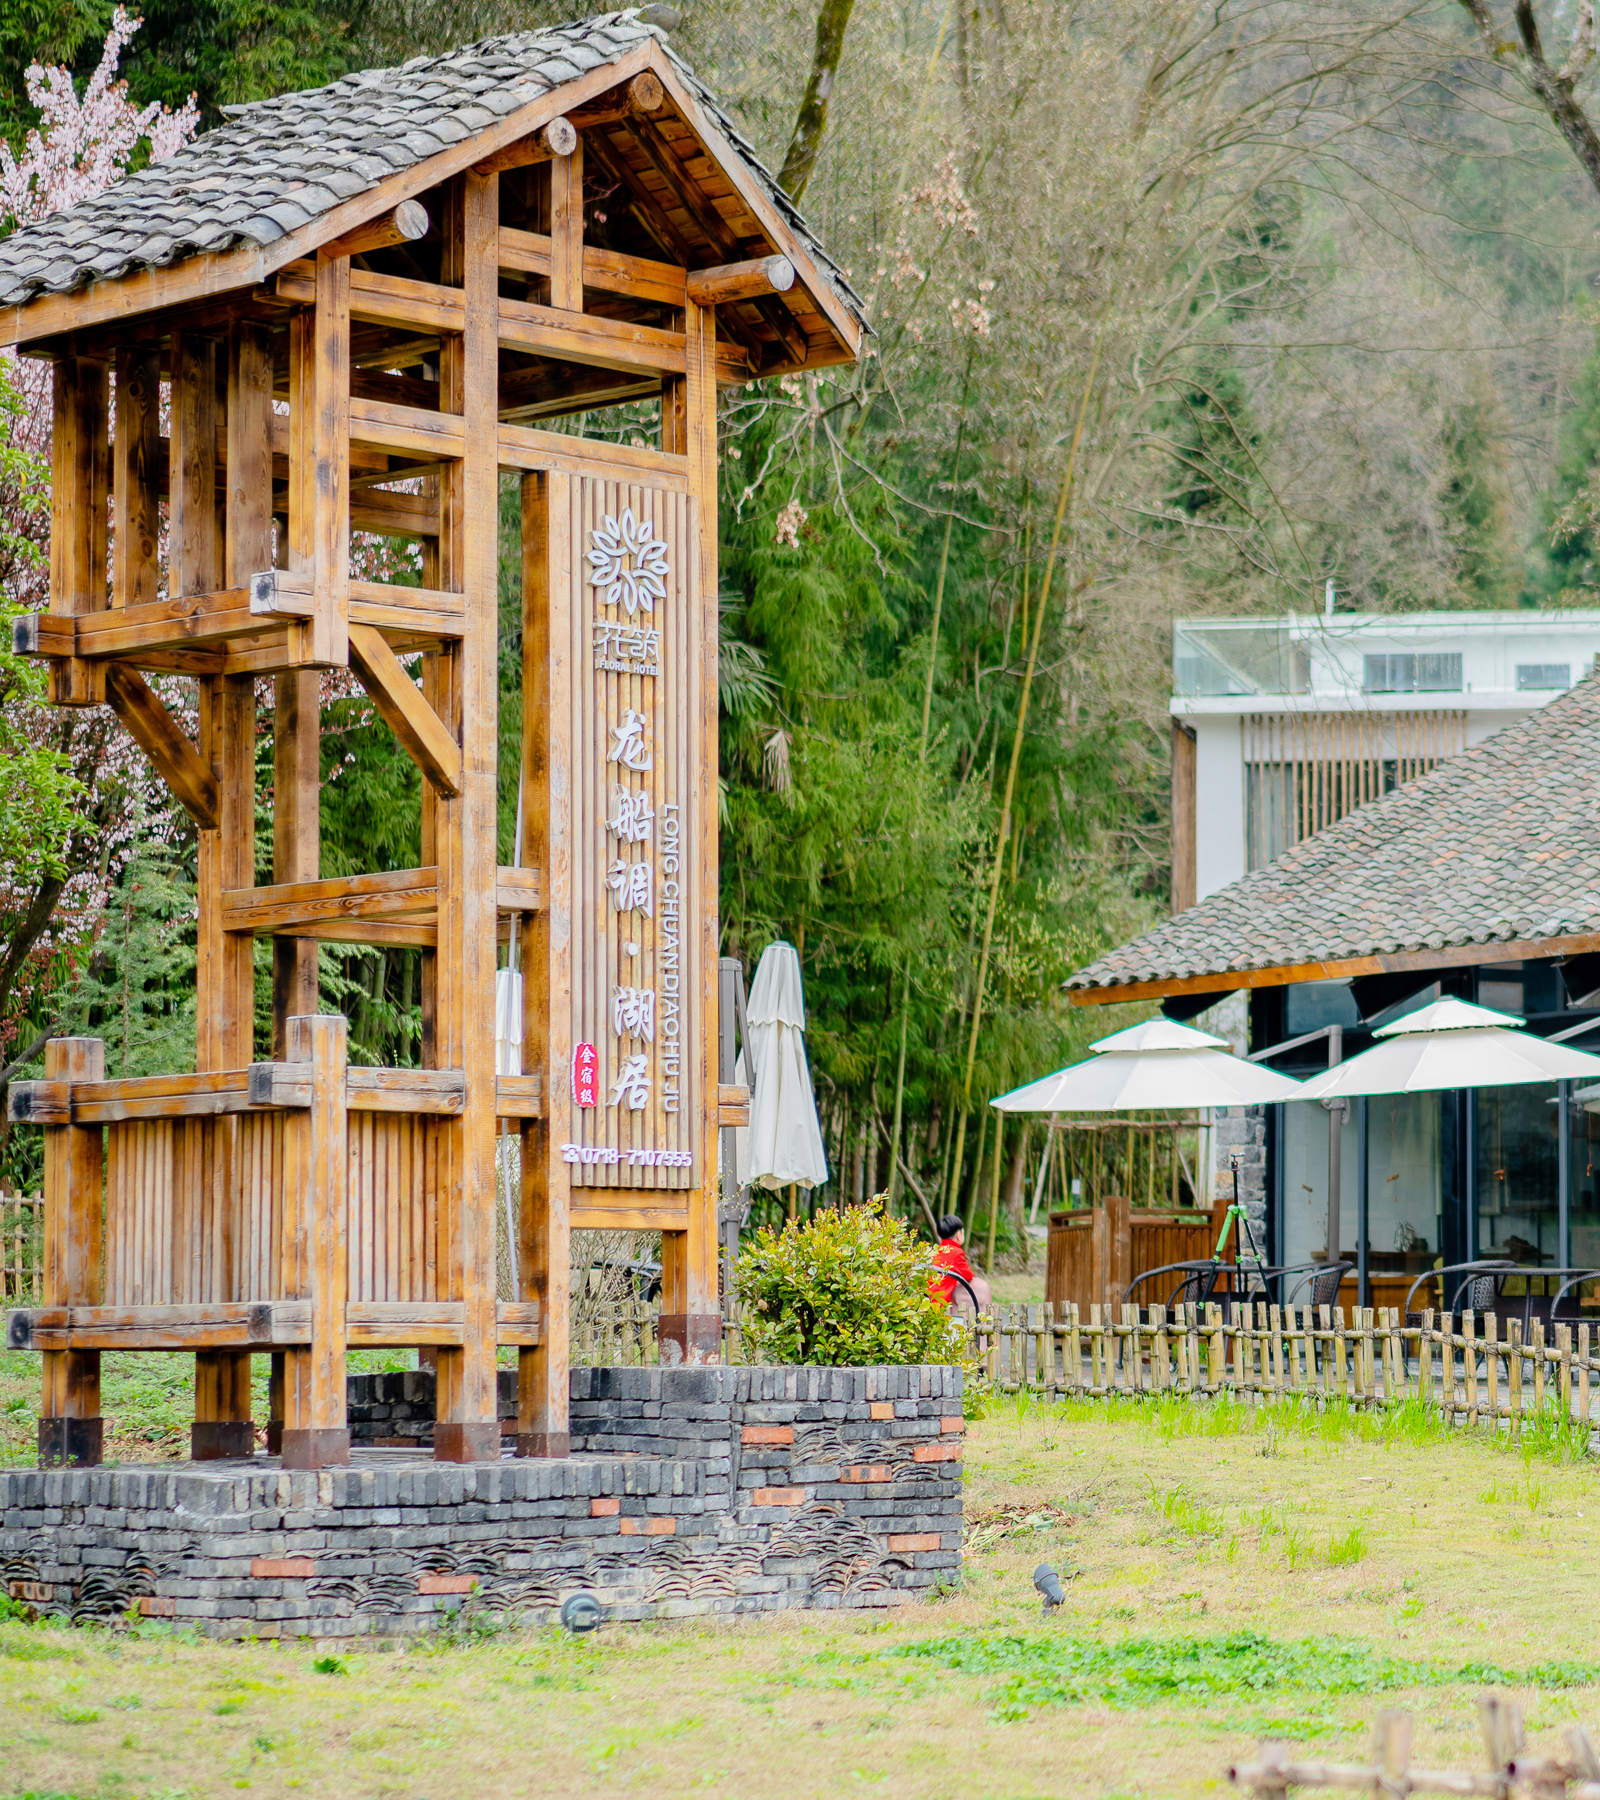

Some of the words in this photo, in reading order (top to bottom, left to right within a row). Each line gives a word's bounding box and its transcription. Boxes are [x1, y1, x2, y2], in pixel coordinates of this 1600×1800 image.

[596, 620, 661, 662] 花筑
[598, 659, 631, 673] FLORAL
[633, 663, 660, 676] HOTEL
[662, 803, 679, 875] LONG
[662, 880, 680, 969] CHUAN
[662, 974, 680, 1037] DIAO
[580, 1045, 595, 1105] 金宿级
[662, 1041, 680, 1076] HU
[662, 1081, 680, 1112] JU
[580, 1147, 692, 1168] 0718-7107555
